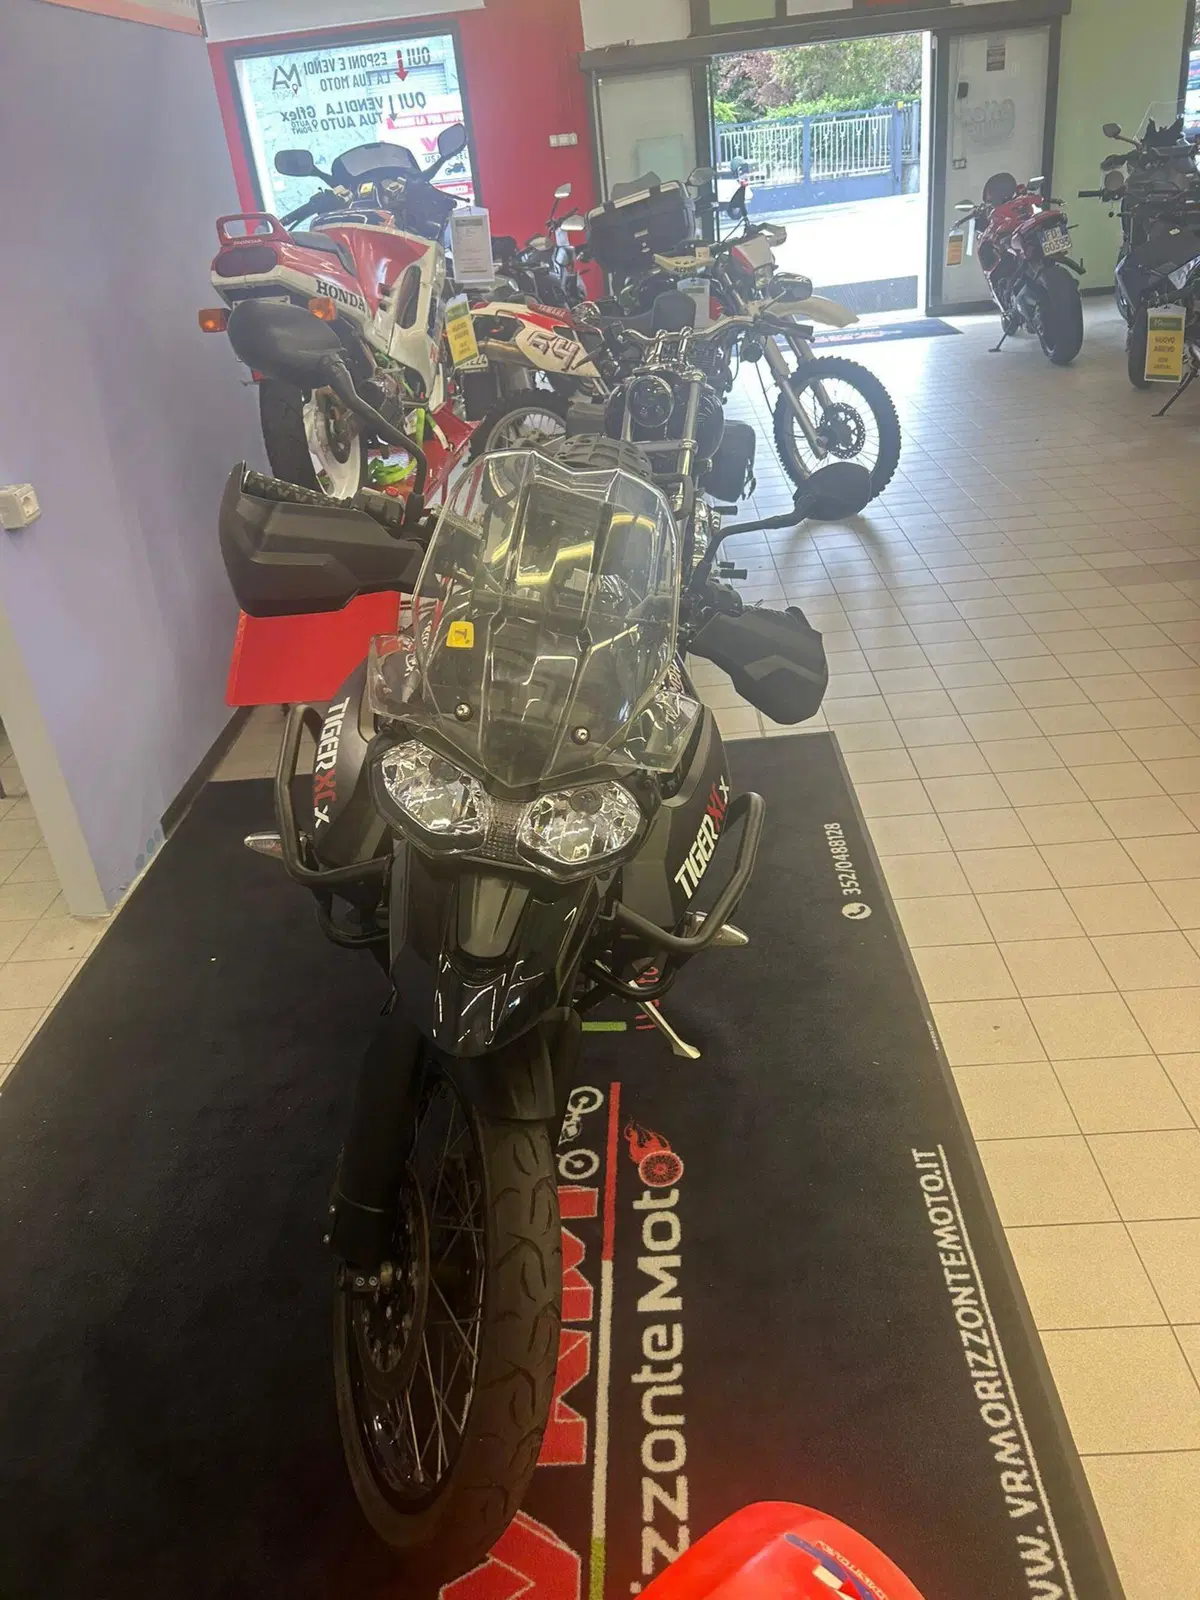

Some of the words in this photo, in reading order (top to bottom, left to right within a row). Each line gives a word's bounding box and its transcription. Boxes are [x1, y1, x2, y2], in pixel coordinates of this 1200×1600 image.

[316, 280, 366, 311] HONDA
[315, 696, 351, 773] TIGER
[674, 813, 719, 899] TIGER
[824, 822, 862, 896] 352/0488128
